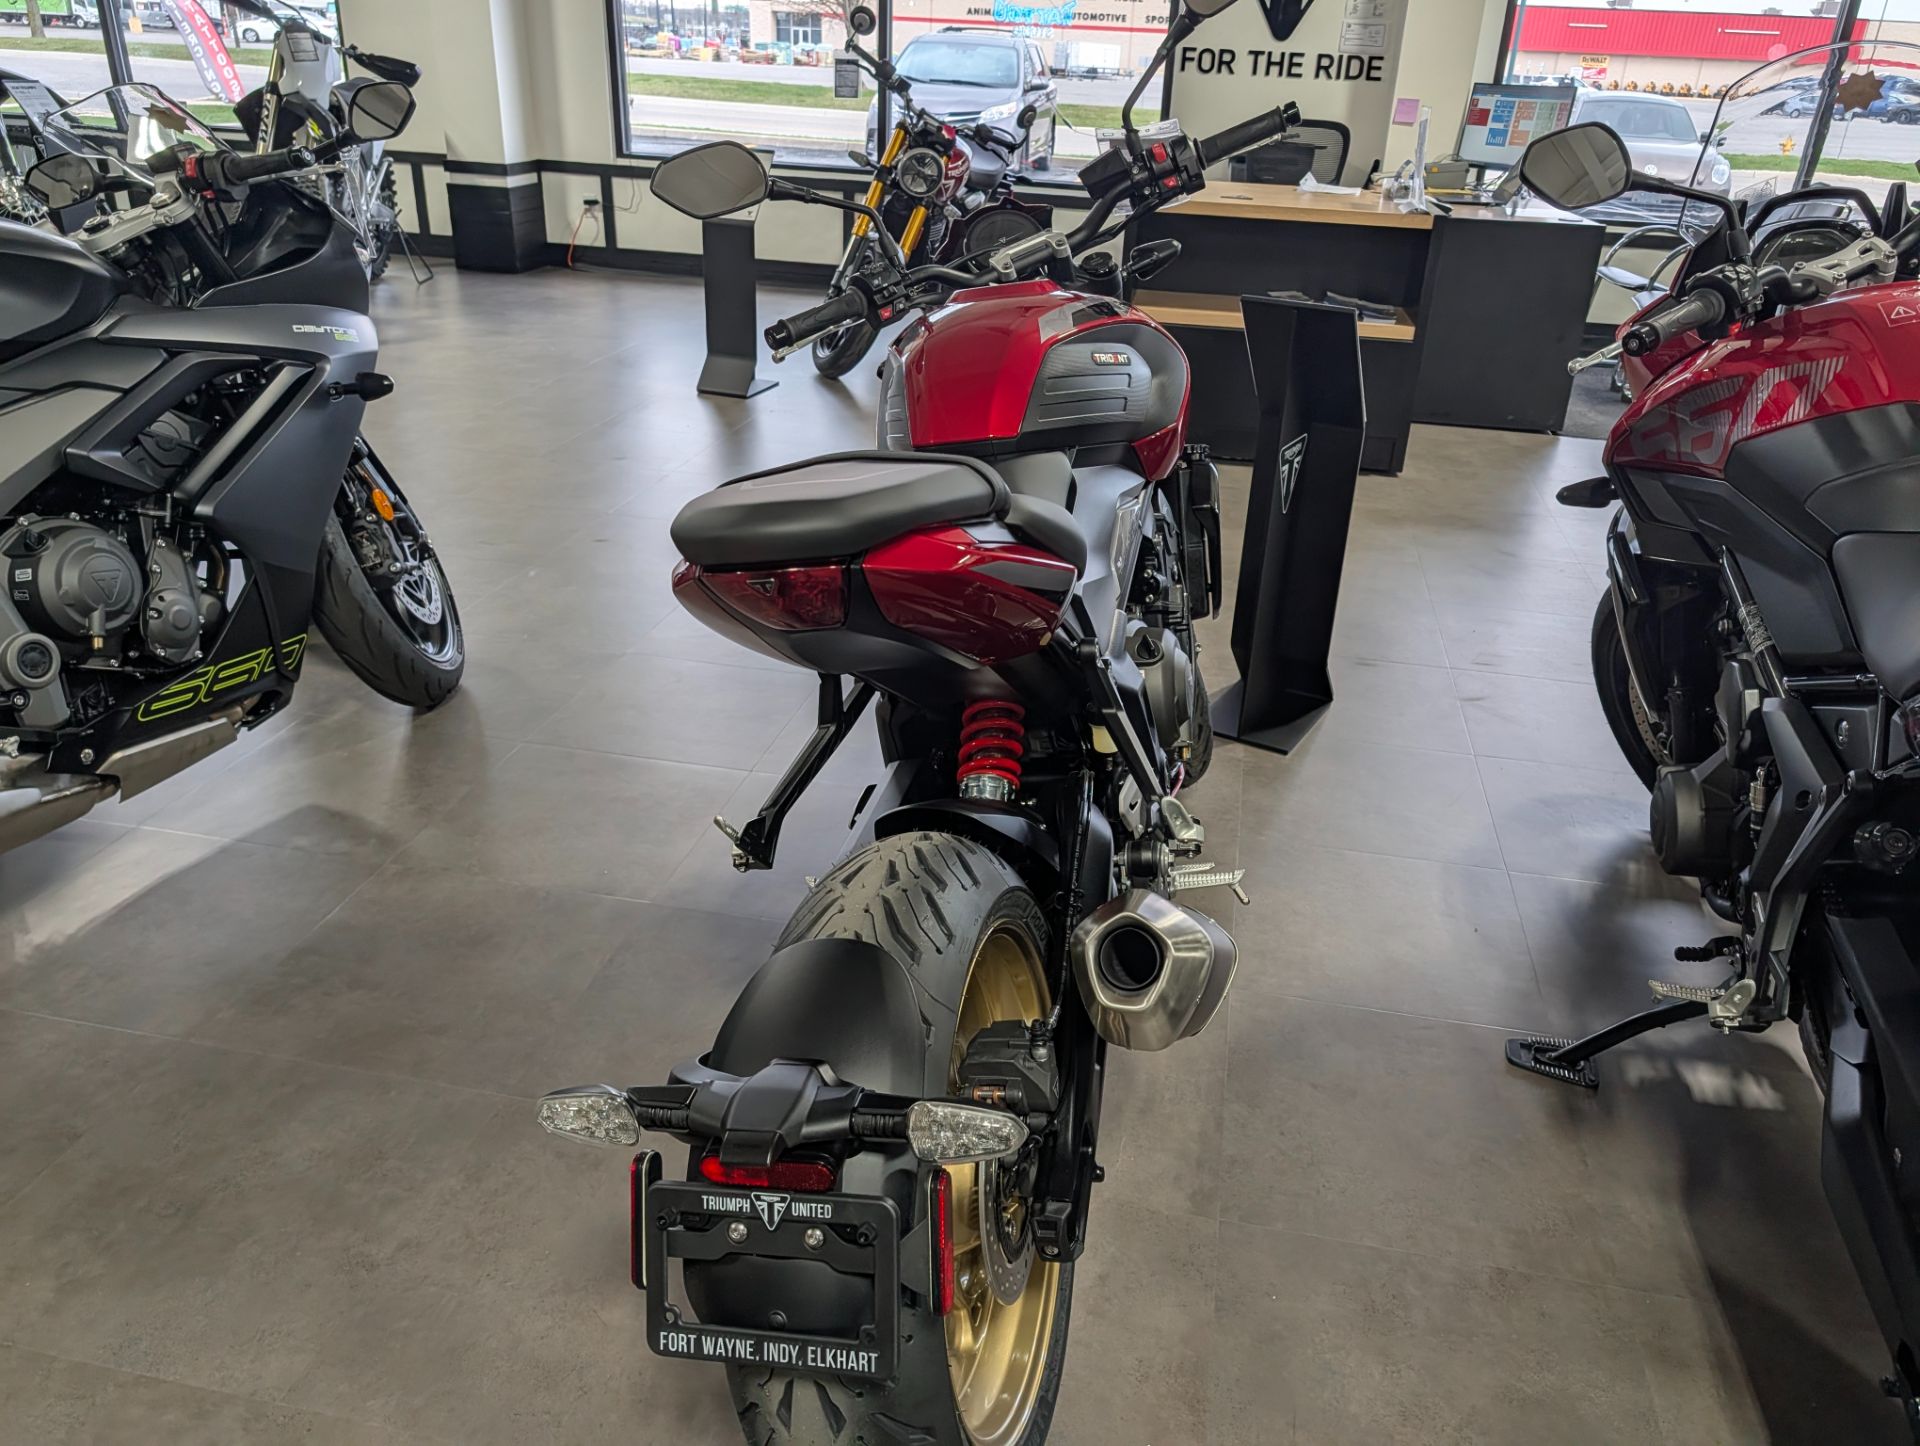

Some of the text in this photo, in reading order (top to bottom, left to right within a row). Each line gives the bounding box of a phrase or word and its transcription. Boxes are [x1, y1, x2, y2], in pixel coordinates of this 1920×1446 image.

[1180, 47, 1385, 81] FOR THE RIDE
[701, 1195, 833, 1219] TRIUMPH UNITED
[659, 1332, 879, 1374] FORT WAYNE, INDY, ELKHART
